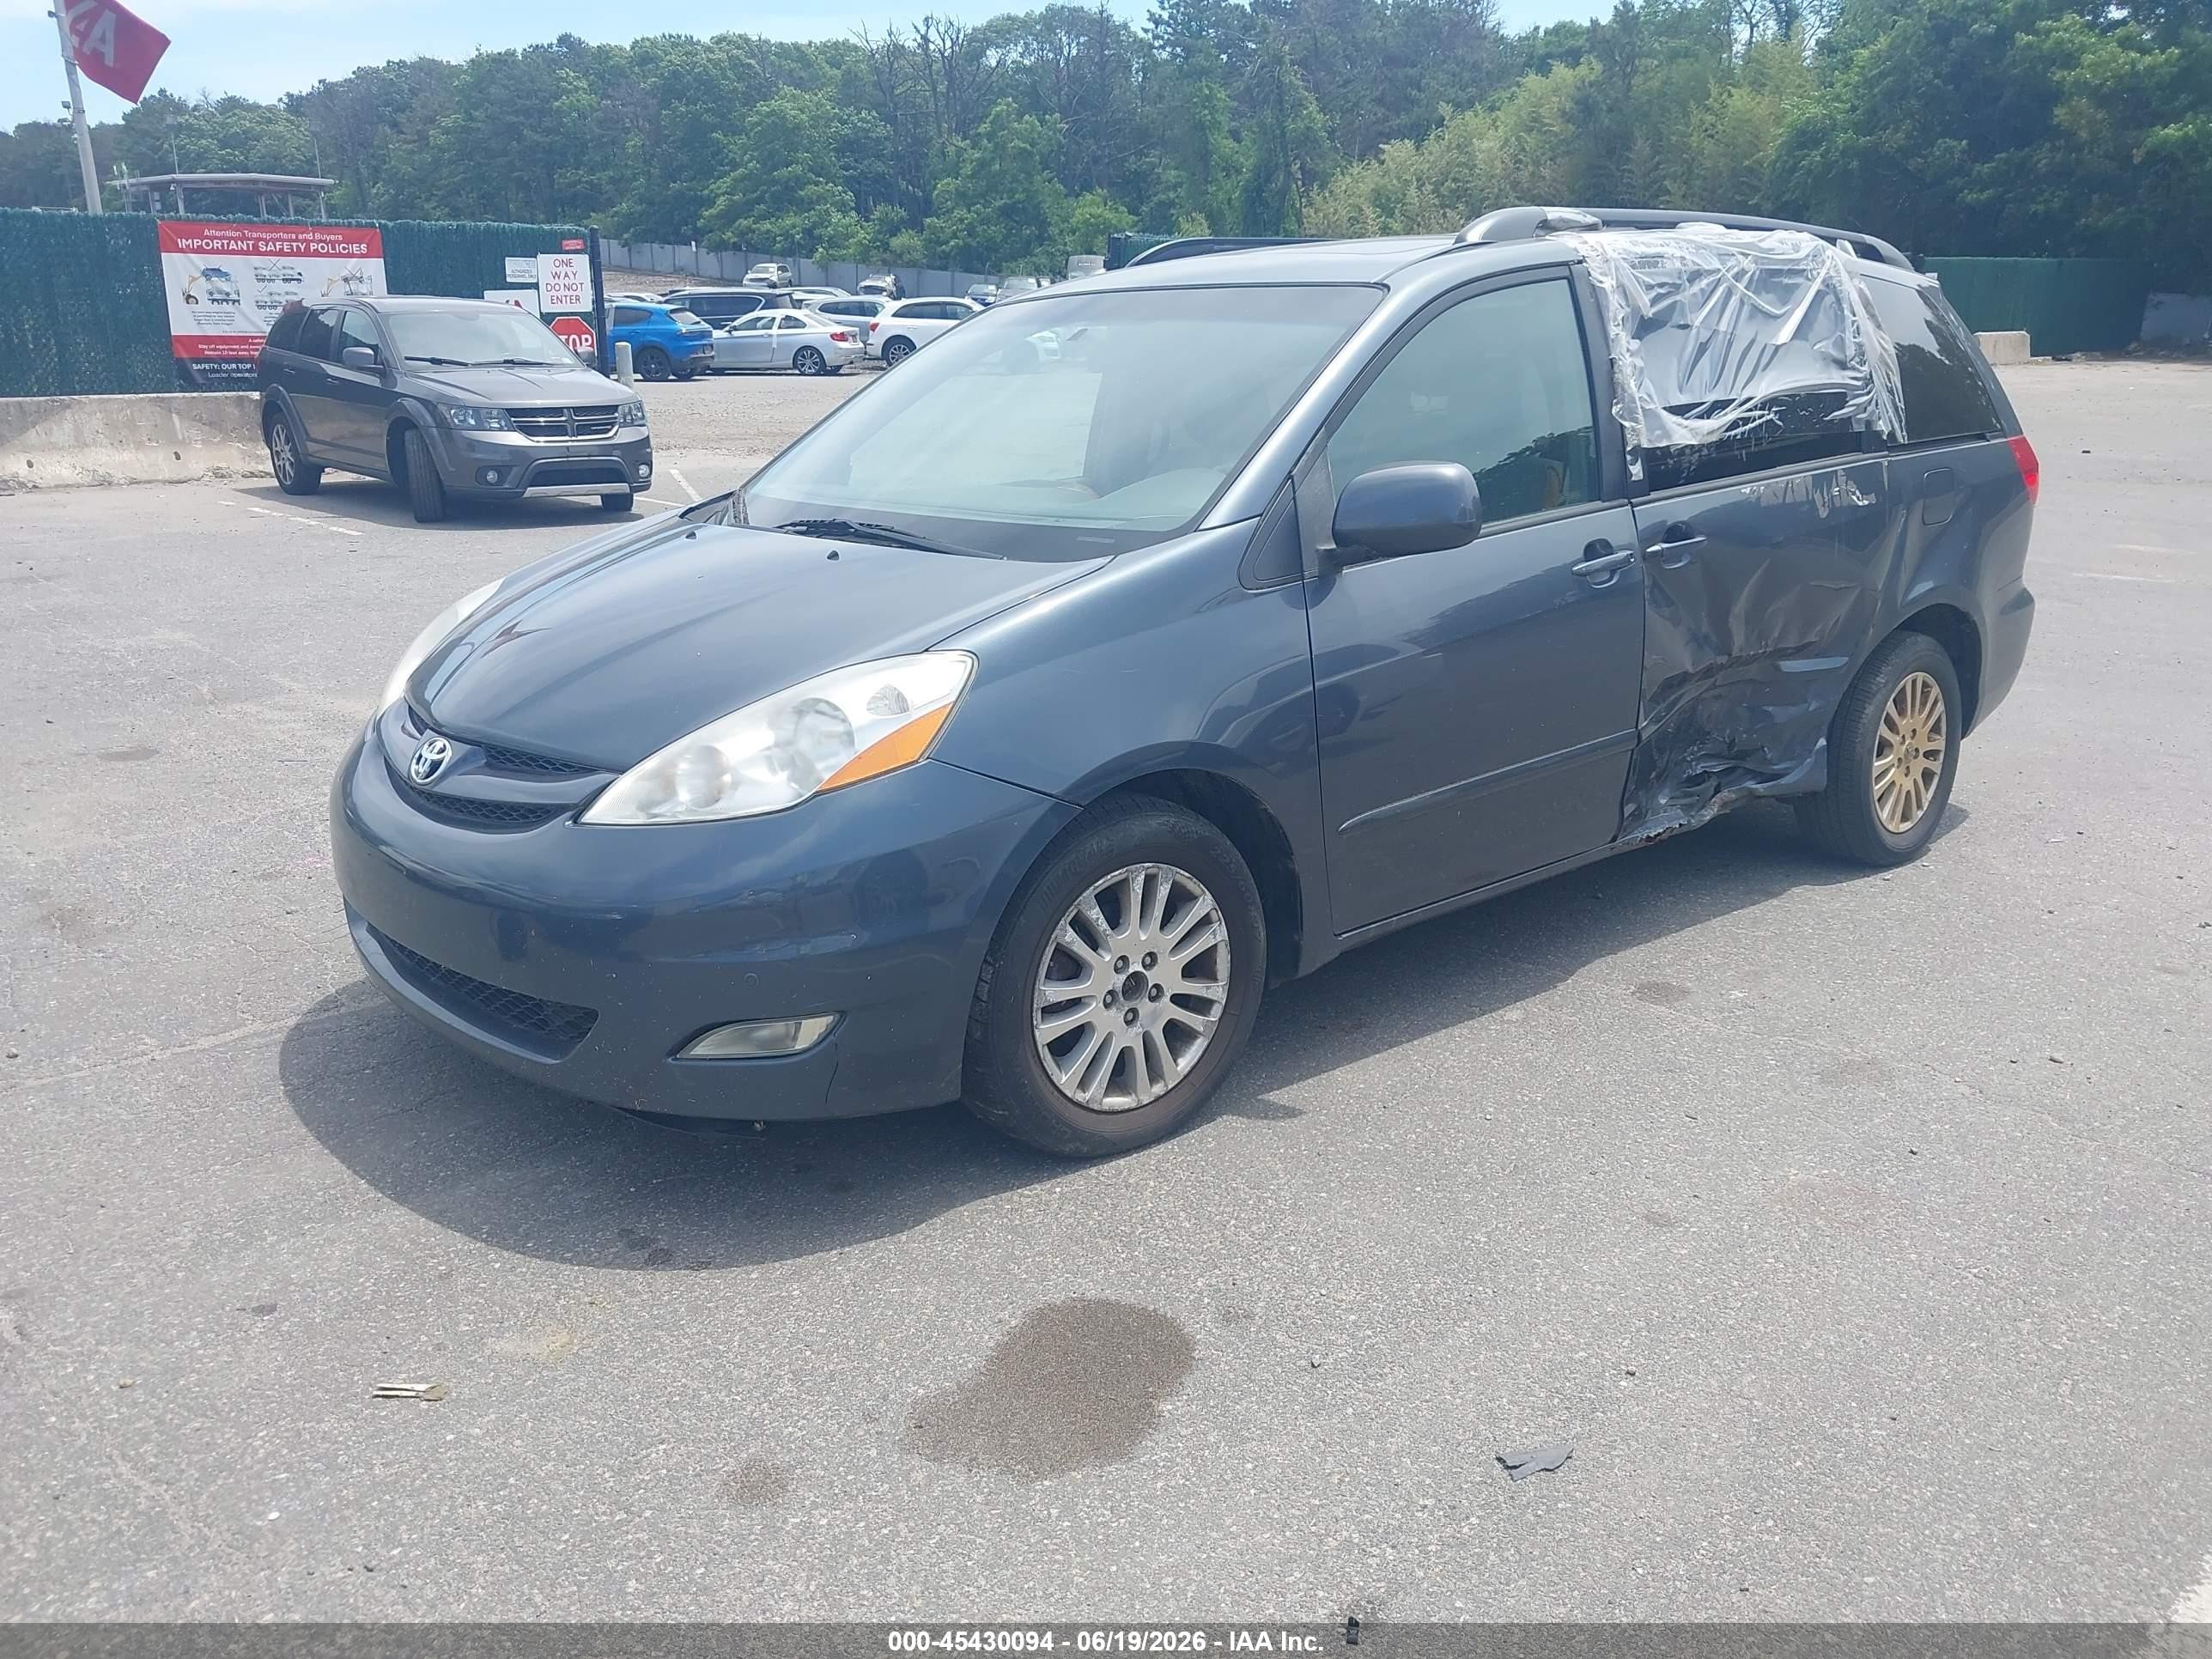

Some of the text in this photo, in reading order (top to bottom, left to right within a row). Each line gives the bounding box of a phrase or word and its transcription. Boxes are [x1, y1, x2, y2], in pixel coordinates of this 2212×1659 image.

[204, 228, 343, 242] Attention Transporters and Buyers
[177, 238, 368, 254] IMPORTANT SAFETY POLICIES
[553, 258, 574, 268] ONE
[550, 270, 578, 280] WAY
[545, 283, 585, 292] DO NOT
[550, 295, 581, 305] ENTER
